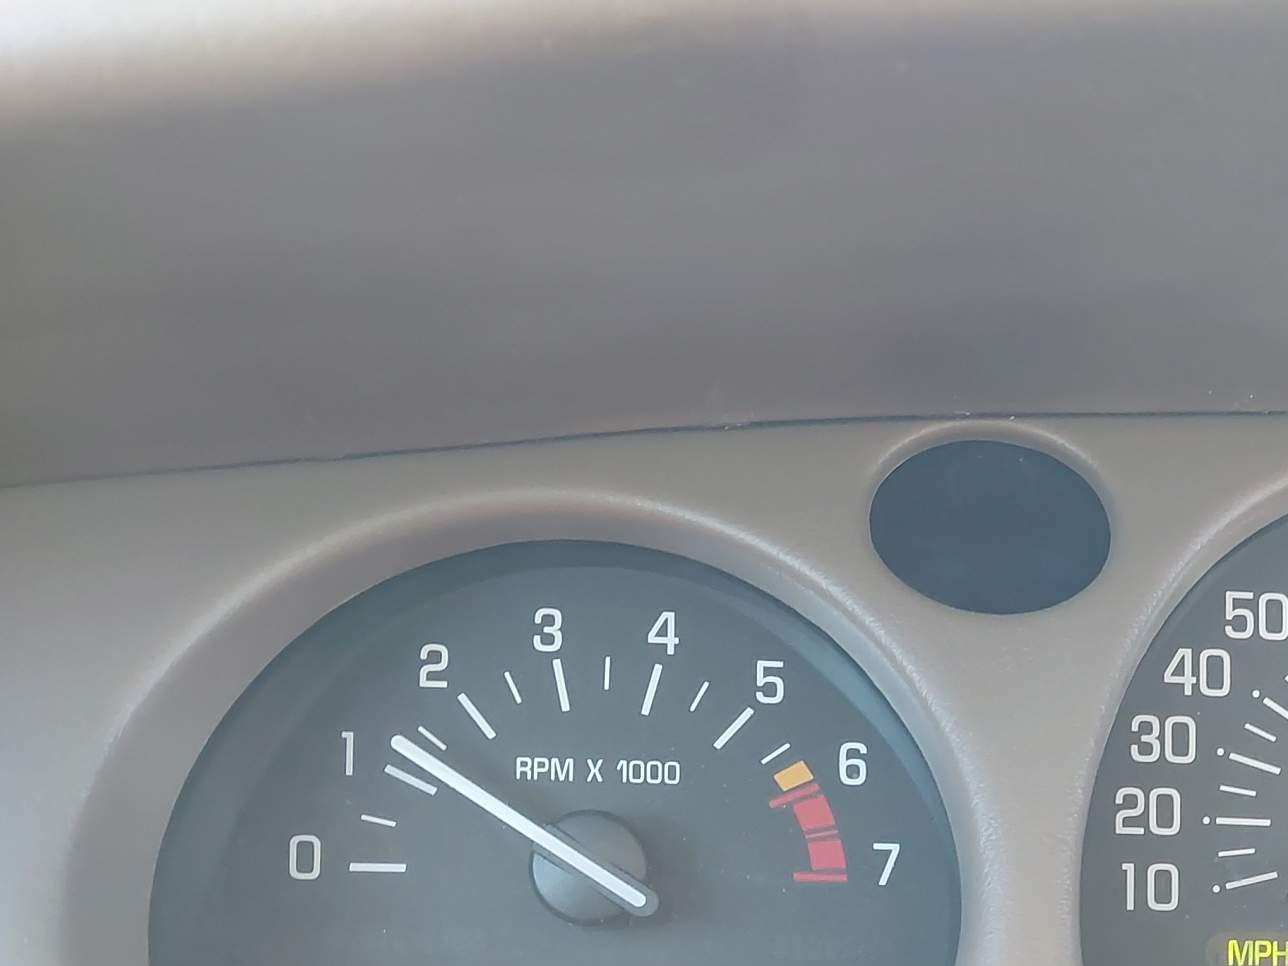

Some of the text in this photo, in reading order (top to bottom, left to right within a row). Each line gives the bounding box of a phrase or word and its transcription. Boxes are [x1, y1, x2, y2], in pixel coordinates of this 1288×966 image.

[533, 607, 563, 652] 3
[647, 611, 680, 655] 4
[419, 643, 449, 689] 2
[755, 660, 784, 704] 5
[1163, 647, 1231, 697] 40
[341, 731, 354, 776] 1
[1130, 714, 1197, 764] 30
[516, 756, 681, 785] RPM X 1000
[838, 742, 868, 786] 6
[1115, 787, 1181, 836] 20
[289, 834, 322, 880] 0
[872, 842, 900, 886] 7
[1121, 862, 1179, 911] 10
